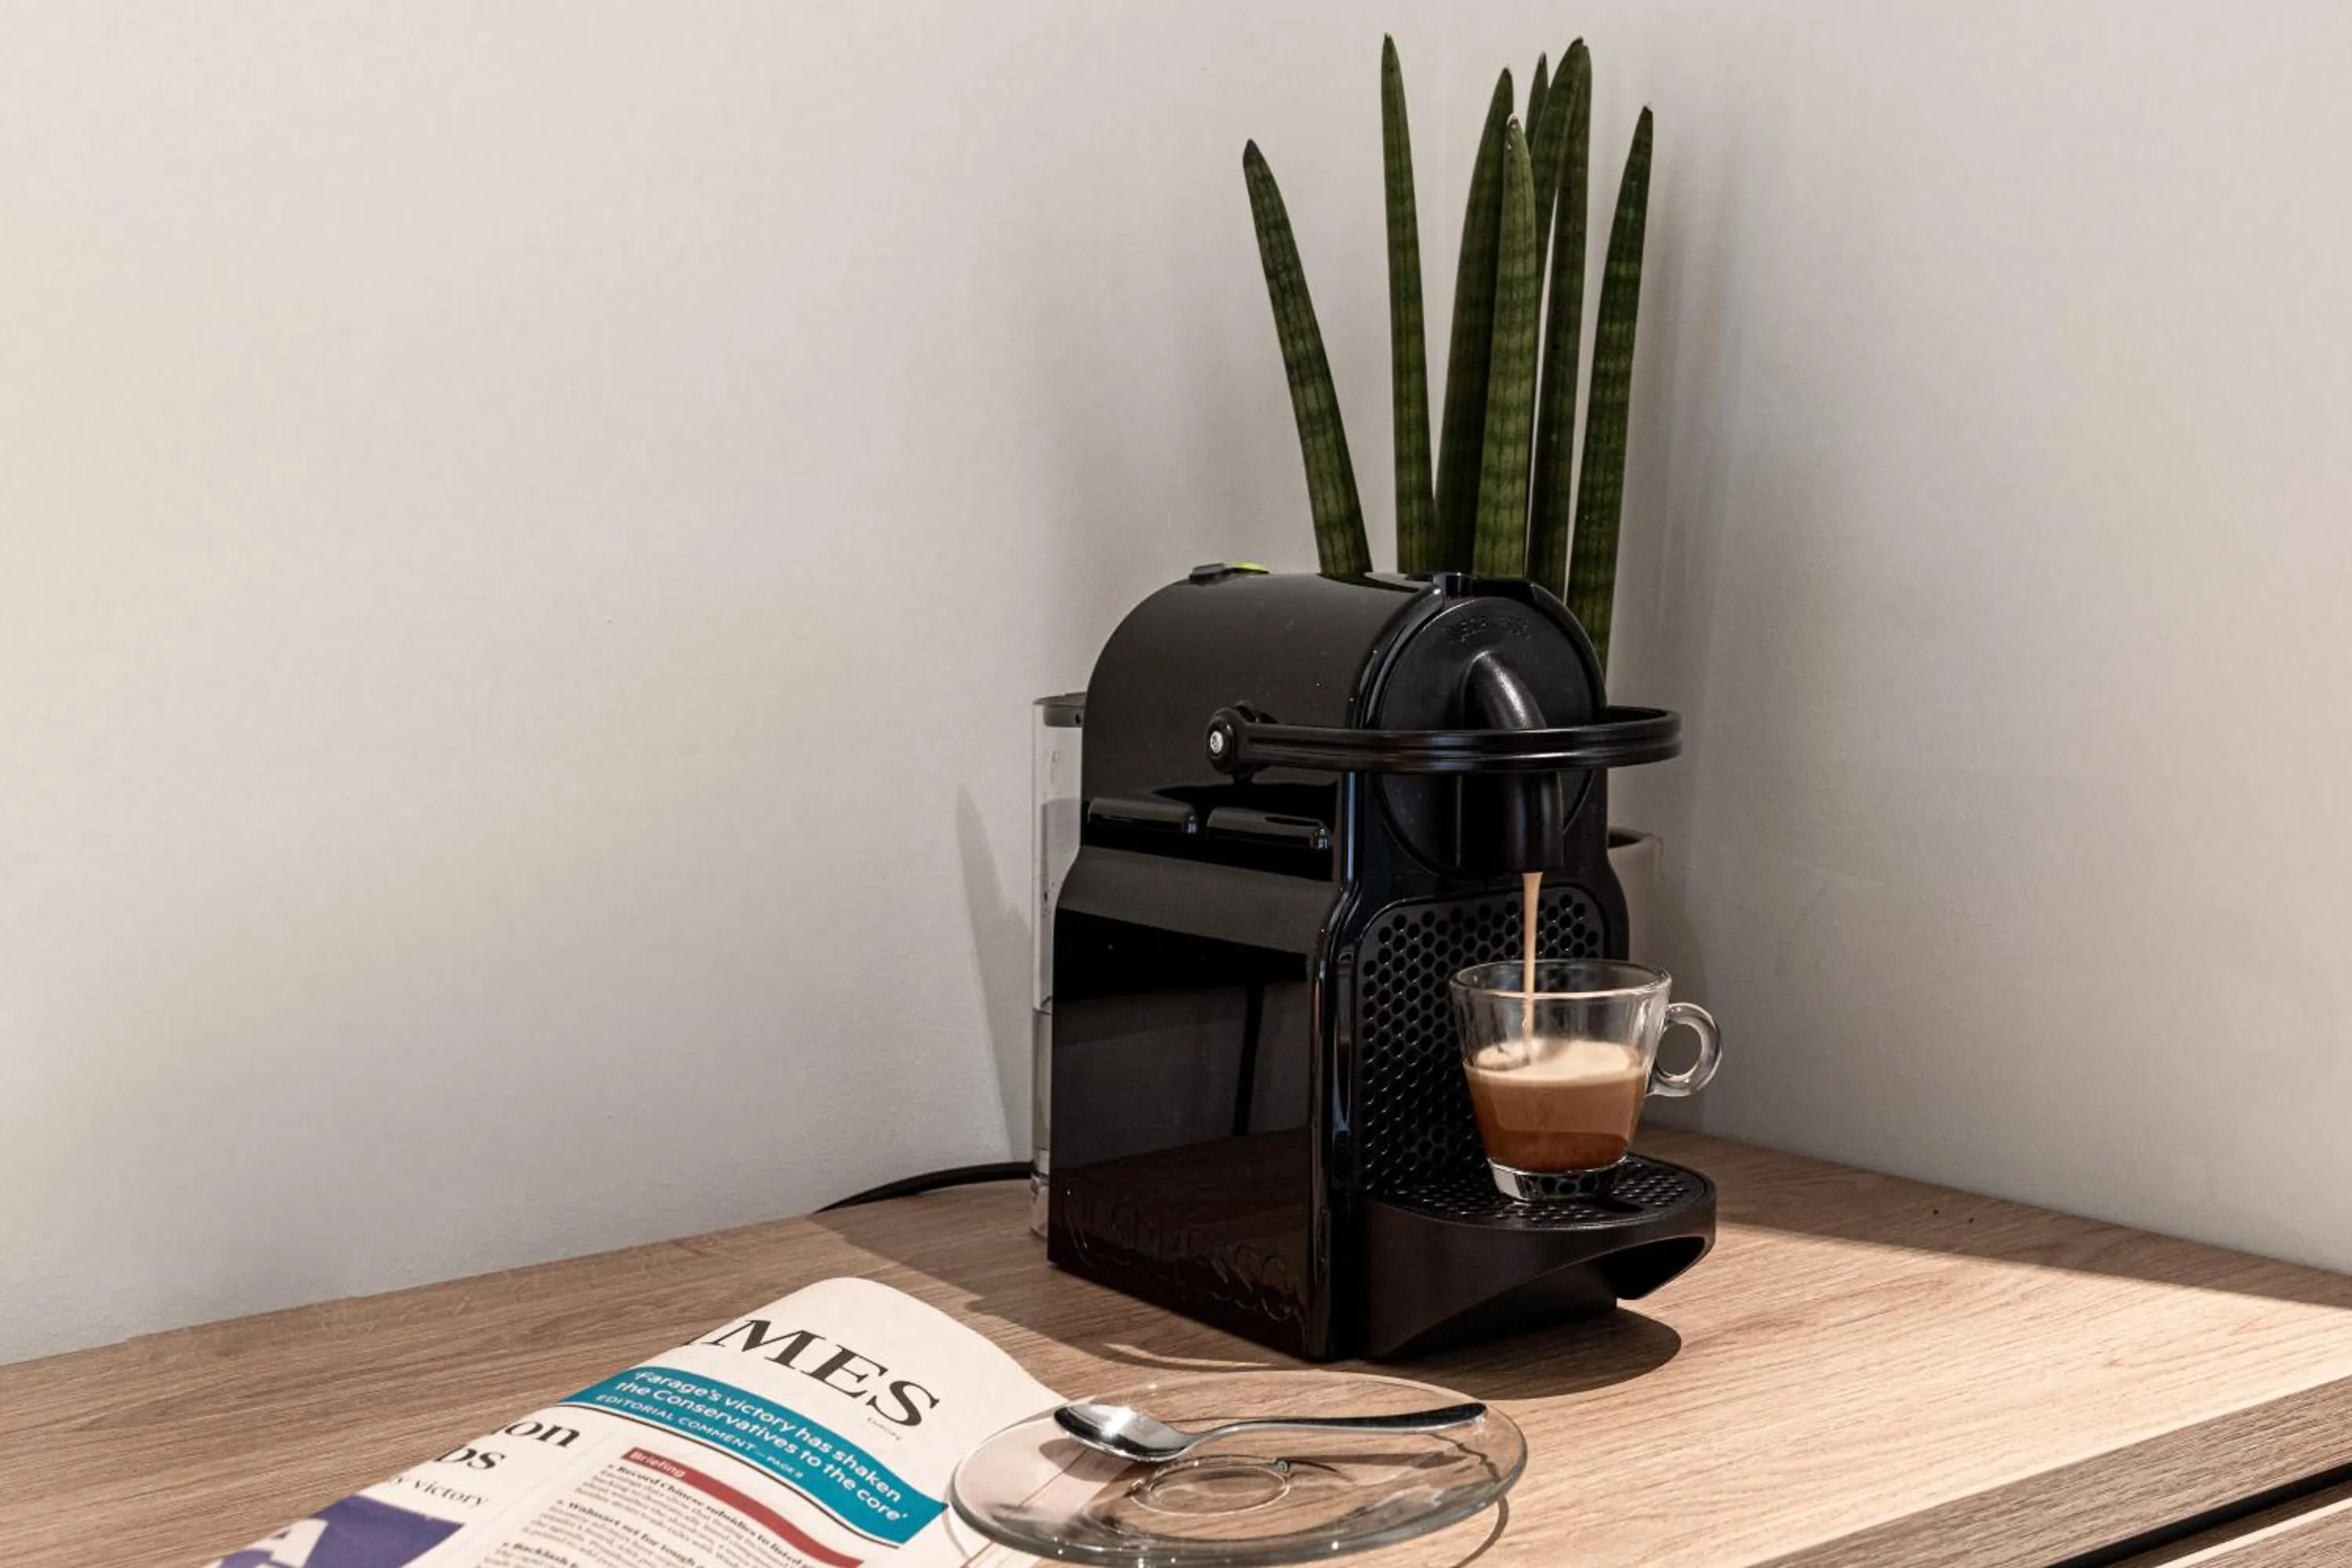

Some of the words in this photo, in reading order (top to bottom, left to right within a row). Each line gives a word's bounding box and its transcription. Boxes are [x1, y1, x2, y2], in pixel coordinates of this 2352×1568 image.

[679, 1319, 940, 1427] MES
[490, 1421, 581, 1449] on
[596, 1393, 675, 1421] EDITORIAL
[677, 1417, 758, 1451] COMMENT
[615, 1381, 652, 1396] the
[652, 1389, 798, 1454] Conservatives
[799, 1449, 822, 1468] to
[823, 1463, 858, 1491] the
[724, 1397, 796, 1432] victory
[794, 1427, 833, 1454] has
[833, 1450, 902, 1503] shaken
[413, 1479, 489, 1507] victory
[630, 1450, 686, 1479] Briefing
[568, 1501, 622, 1526] Walmart
[641, 1534, 659, 1546] for
[617, 1467, 661, 1486] Record
[660, 1482, 706, 1506] Chinese
[706, 1504, 757, 1537] subsidies
